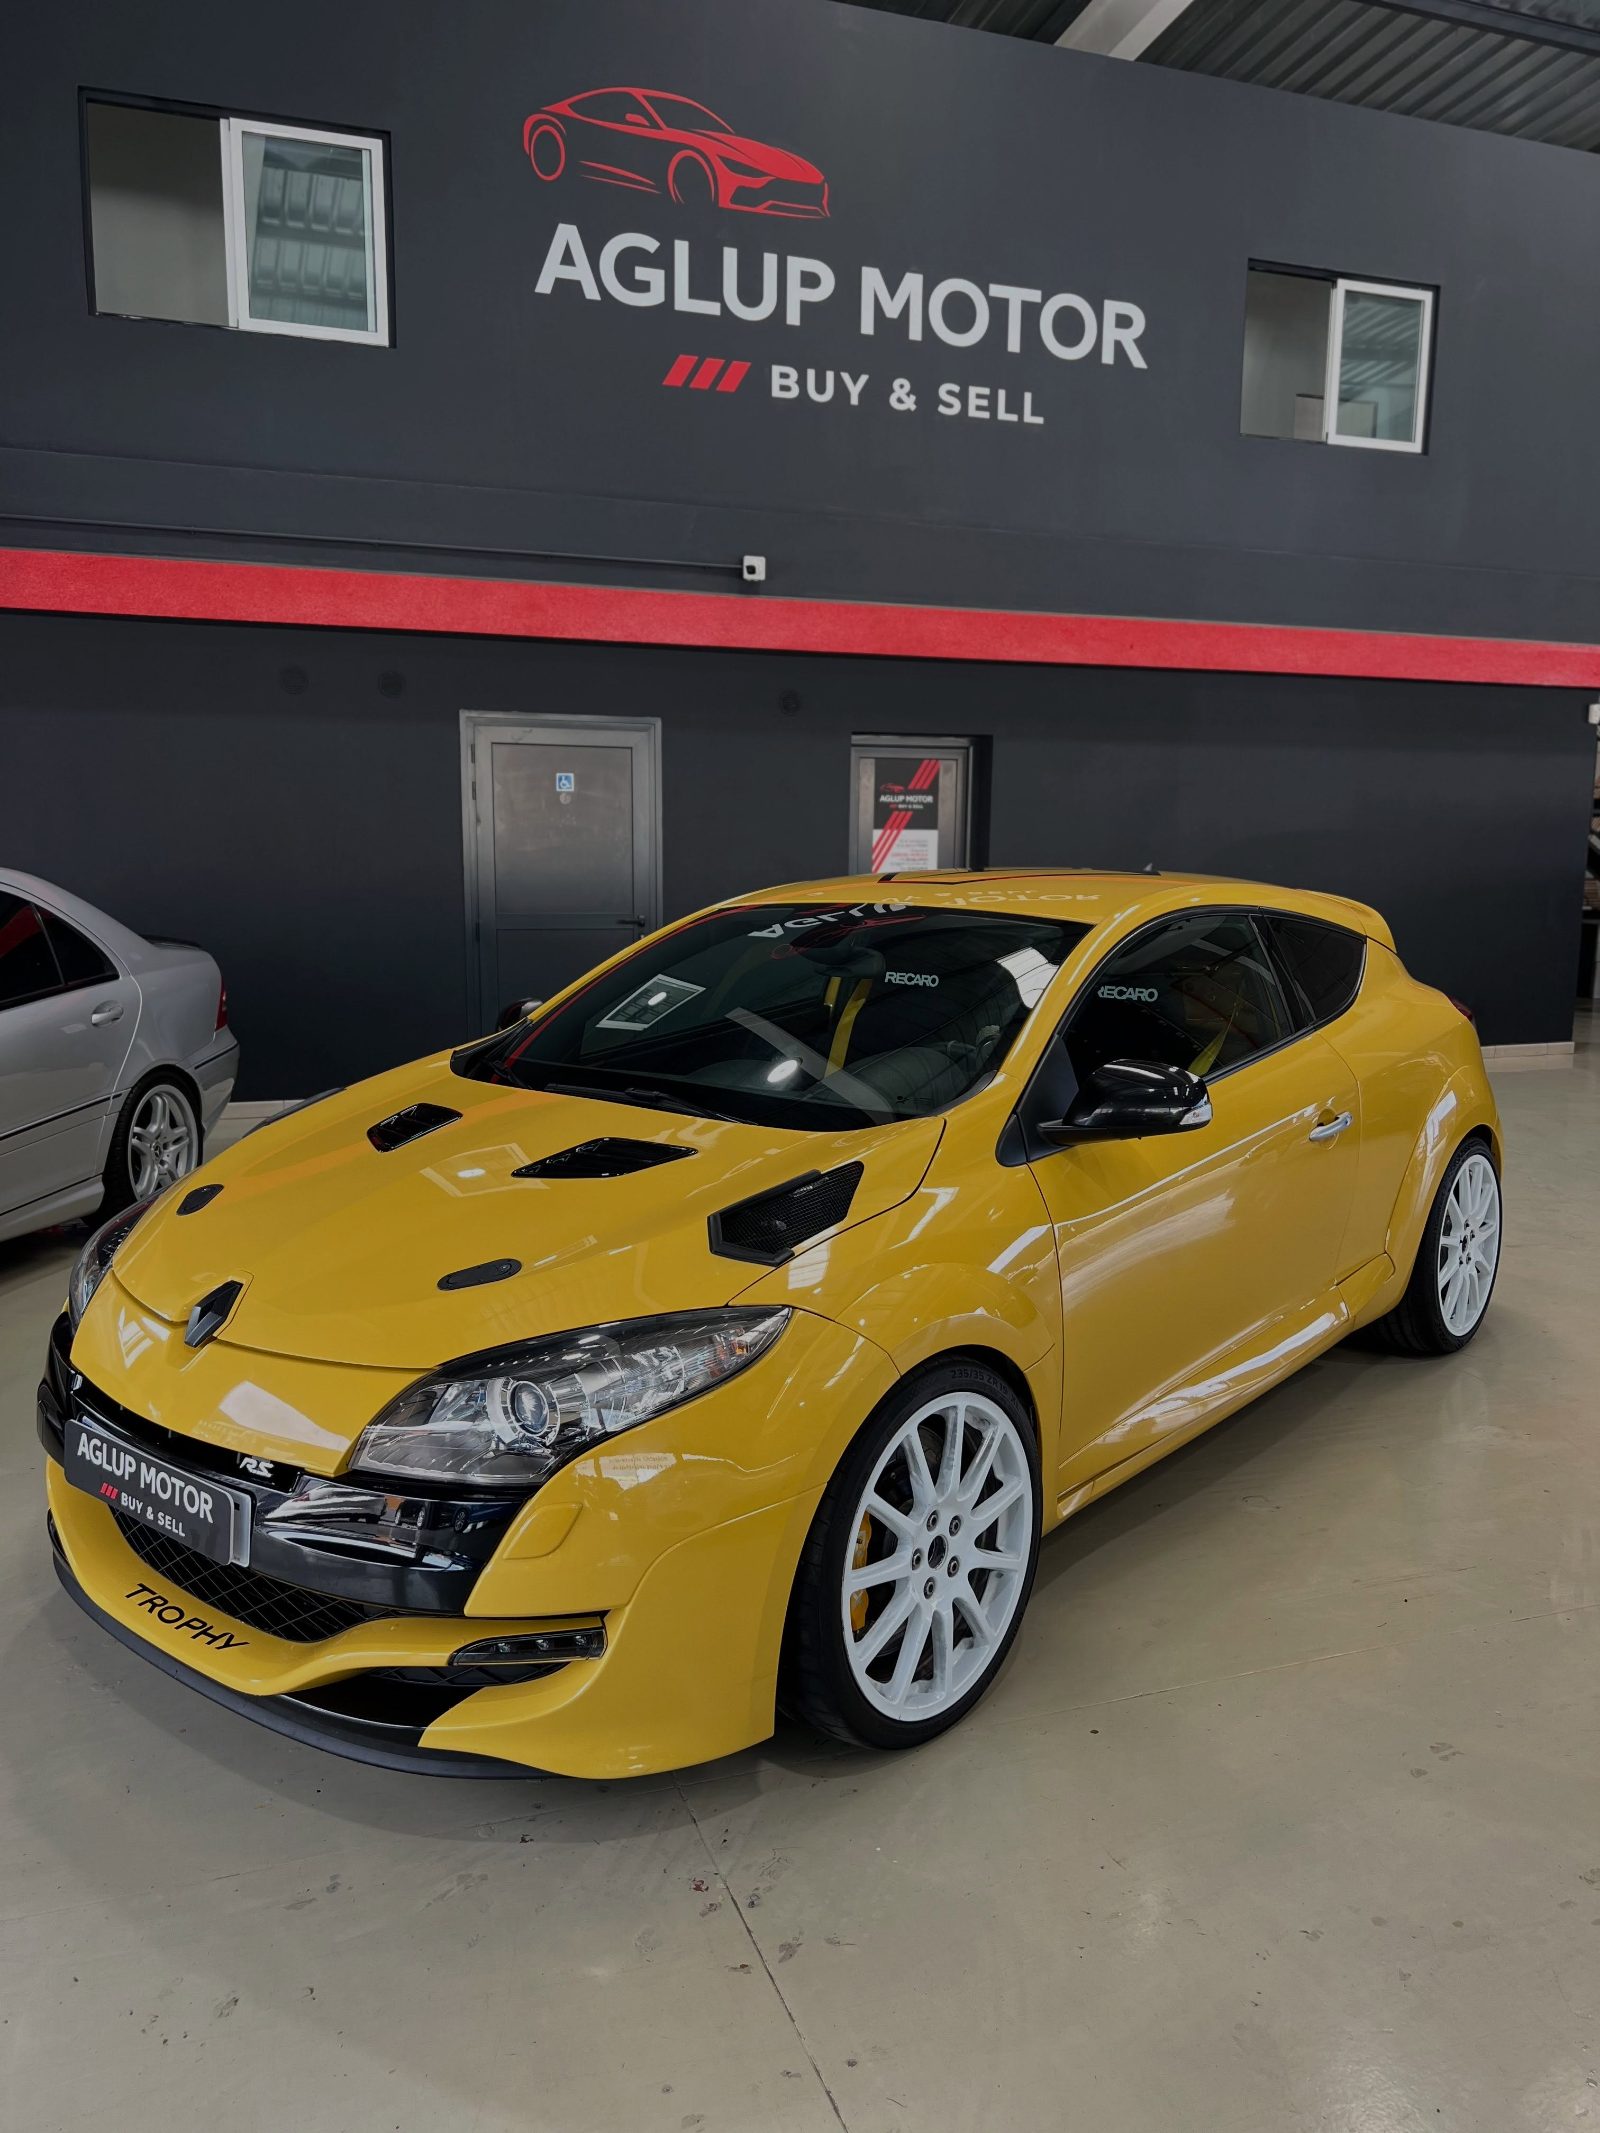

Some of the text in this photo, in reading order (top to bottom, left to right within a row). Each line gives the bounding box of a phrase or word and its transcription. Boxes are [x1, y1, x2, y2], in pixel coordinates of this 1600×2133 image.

[534, 222, 1148, 369] AGLUP MOTOR
[771, 364, 1045, 424] BUY & SELL
[879, 794, 934, 804] AGLUP MOTOR
[884, 971, 939, 987] RECARO
[77, 1432, 213, 1524] AGLUP MOTOR
[239, 1457, 274, 1477] RS
[120, 1492, 186, 1537] BUY & SELL
[125, 1583, 250, 1650] TROPHY
